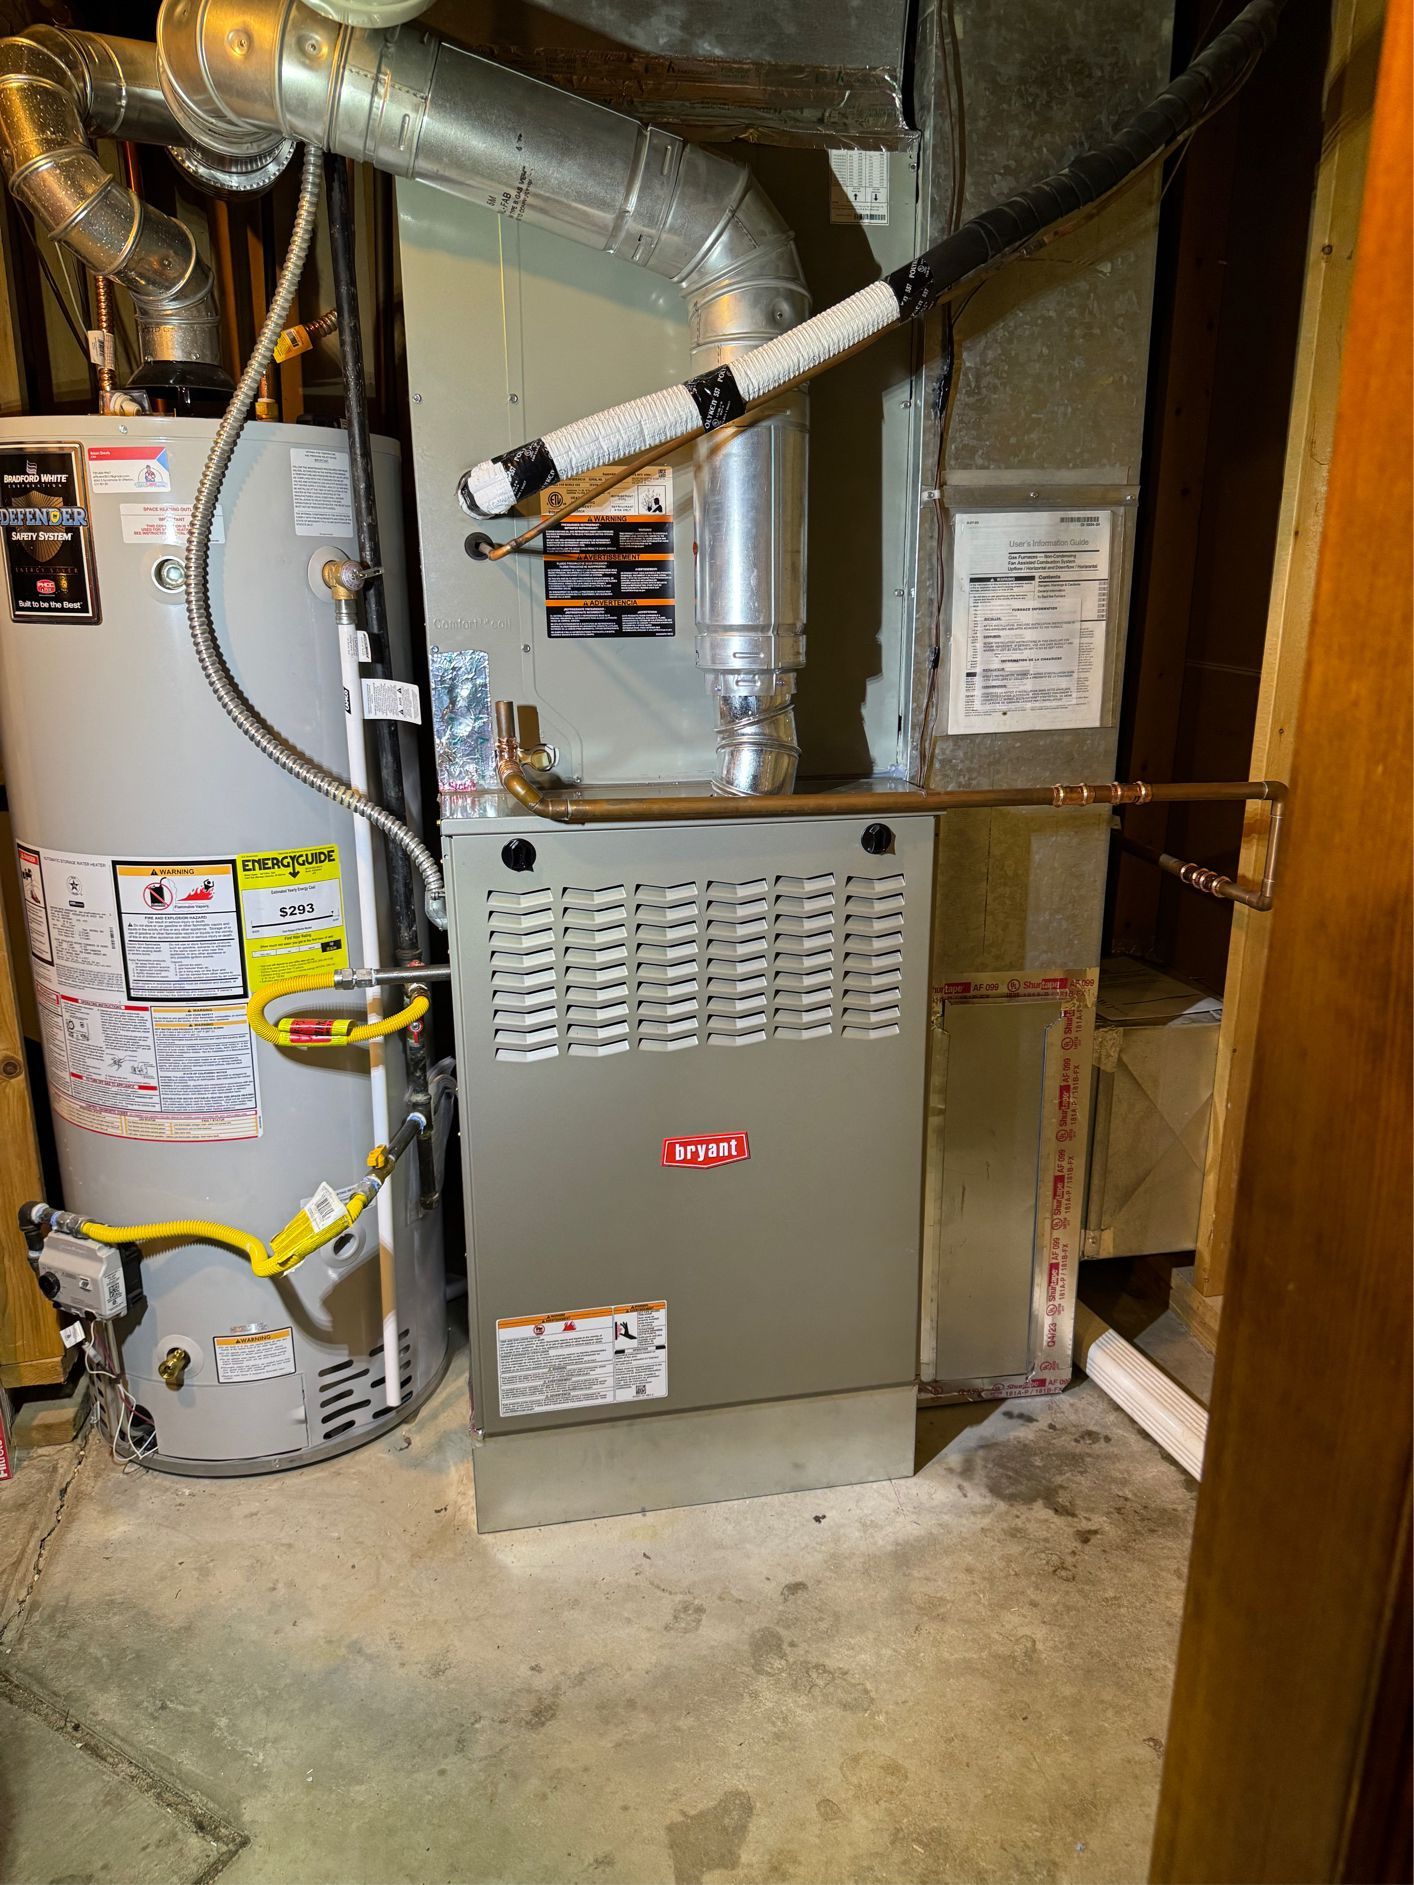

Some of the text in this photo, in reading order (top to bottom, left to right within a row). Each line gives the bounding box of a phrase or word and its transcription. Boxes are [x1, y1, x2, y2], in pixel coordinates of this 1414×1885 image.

[704, 400, 718, 428] OLYKEN
[4, 474, 67, 483] BRADFORD WHITE
[0, 508, 88, 526] DEFENDER
[12, 532, 72, 541] SAFETY SYSTEM
[242, 850, 335, 872] ENERGYGUIDE
[279, 903, 314, 918] $293
[1023, 981, 1060, 989] Shurtape
[1062, 1073, 1070, 1083] AF
[1060, 1091, 1069, 1127] Shurtape
[675, 1139, 737, 1161] bryant
[1057, 1162, 1064, 1173] AF
[1054, 1183, 1064, 1216] Shurtape
[1052, 1249, 1059, 1261] AF
[1049, 1269, 1058, 1302] Shurtape
[241, 1335, 271, 1343] WARNING
[1047, 1323, 1056, 1347] Q4/23
